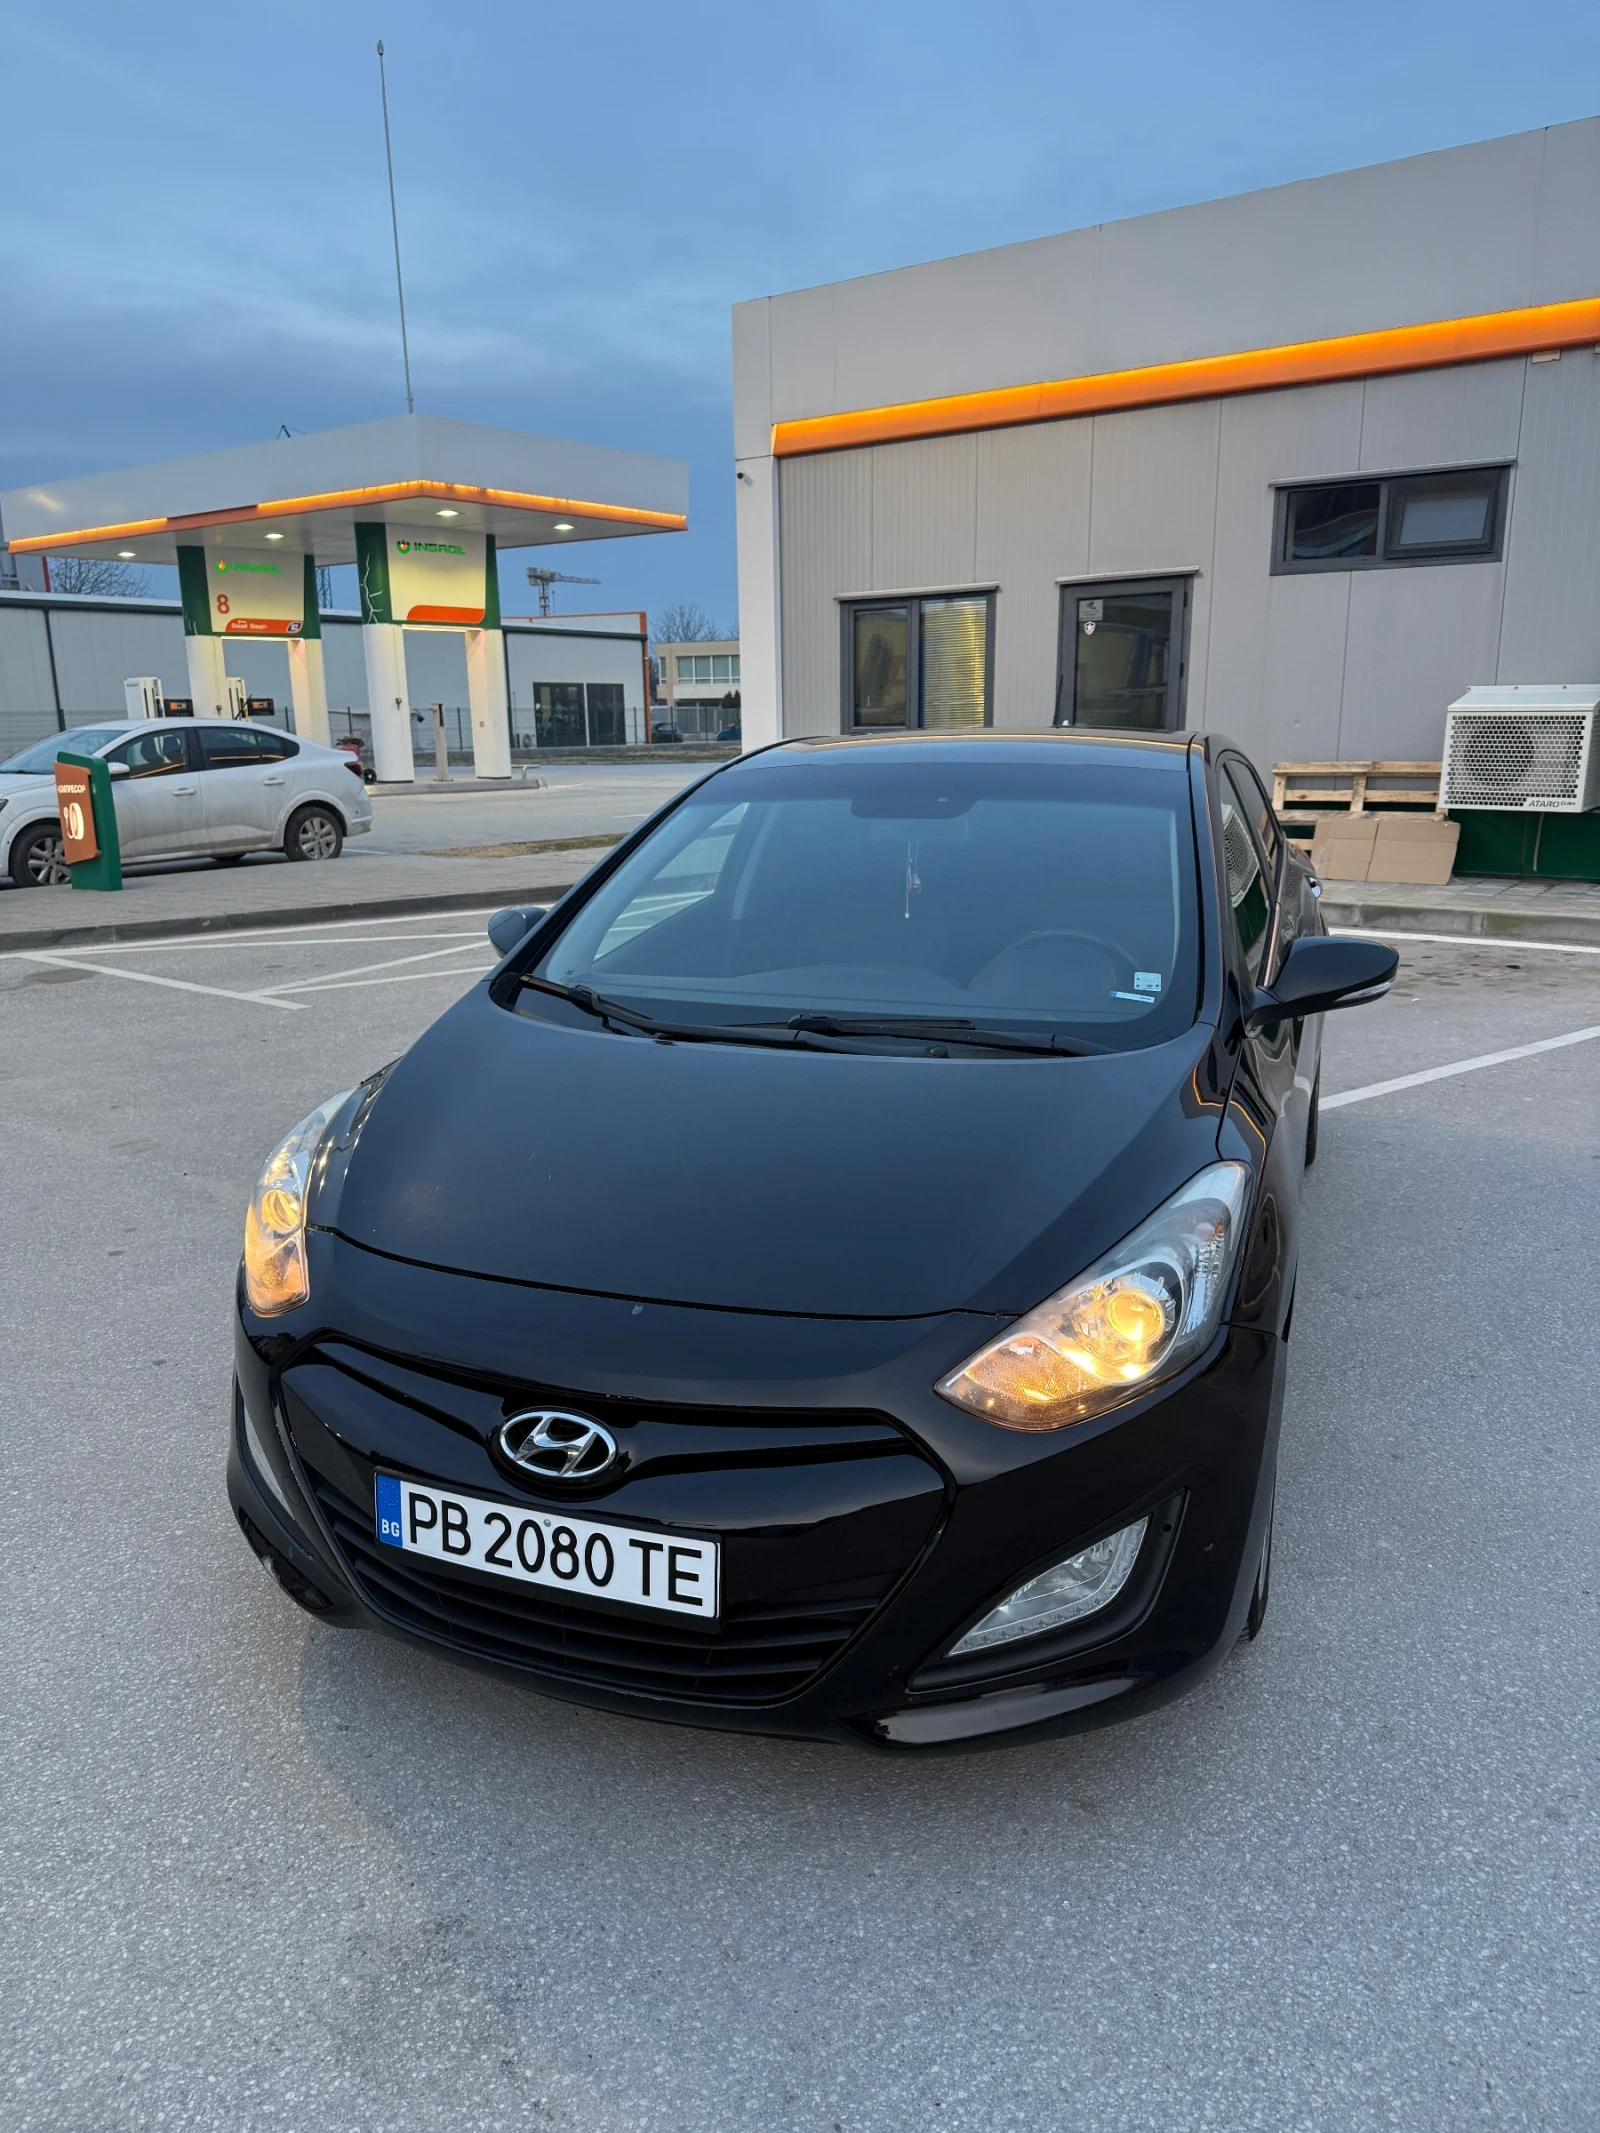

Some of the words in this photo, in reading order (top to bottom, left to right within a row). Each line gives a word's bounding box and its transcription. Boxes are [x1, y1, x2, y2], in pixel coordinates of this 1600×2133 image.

[216, 593, 230, 614] 8
[1528, 800, 1560, 808] ATARO
[381, 1518, 400, 1537] BG
[408, 1491, 471, 1556] PB
[483, 1511, 614, 1587] 2080
[628, 1537, 703, 1607] TE
